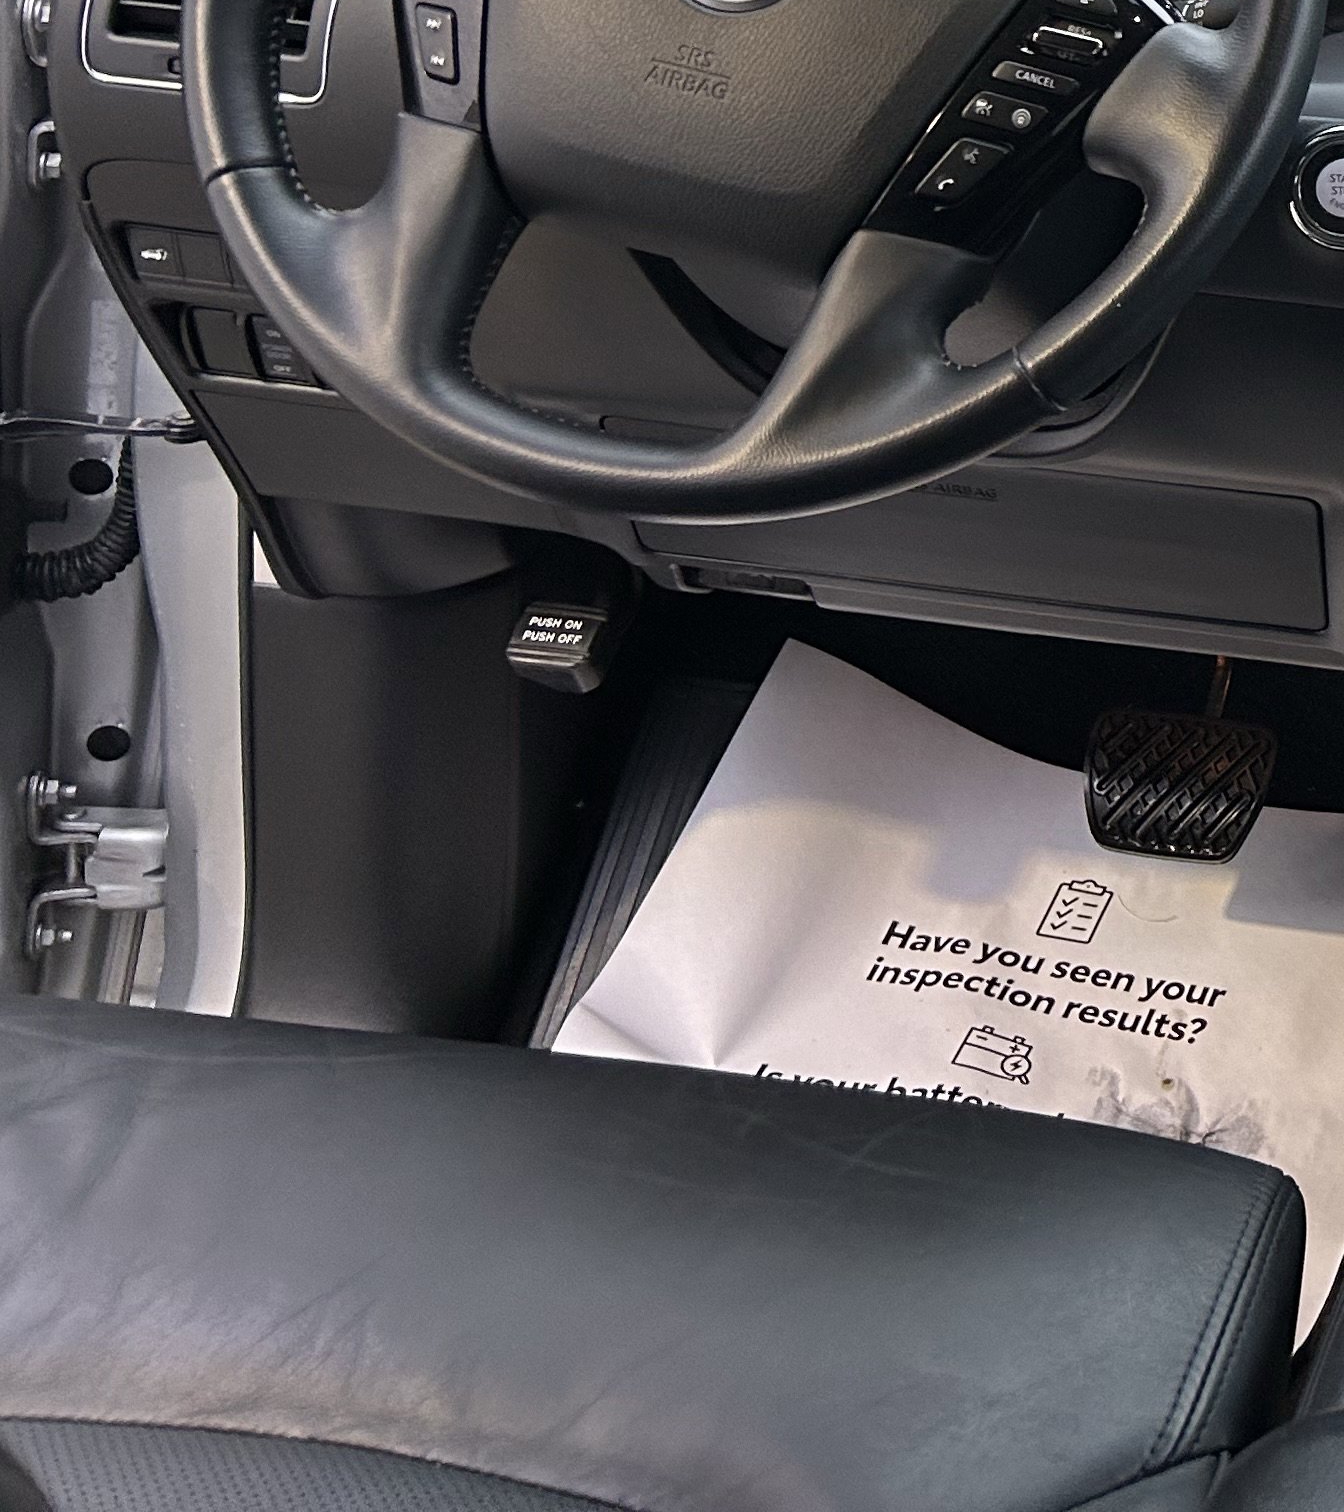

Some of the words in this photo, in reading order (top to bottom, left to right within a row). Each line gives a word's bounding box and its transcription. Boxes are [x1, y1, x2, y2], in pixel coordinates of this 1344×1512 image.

[1193, 9, 1204, 19] LO
[674, 44, 714, 68] SRS
[644, 64, 729, 100] AIRBAG
[1015, 70, 1055, 89] CANCEL
[529, 616, 562, 629] PUSH
[564, 619, 583, 630] ON
[522, 629, 555, 642] PUSH
[557, 633, 582, 645] OFF
[881, 920, 971, 955] Have
[972, 941, 1046, 975] you
[1049, 959, 1136, 992] seen
[1138, 976, 1228, 1008] your
[865, 955, 1056, 1015] inspection
[1062, 1000, 1208, 1044] results?
